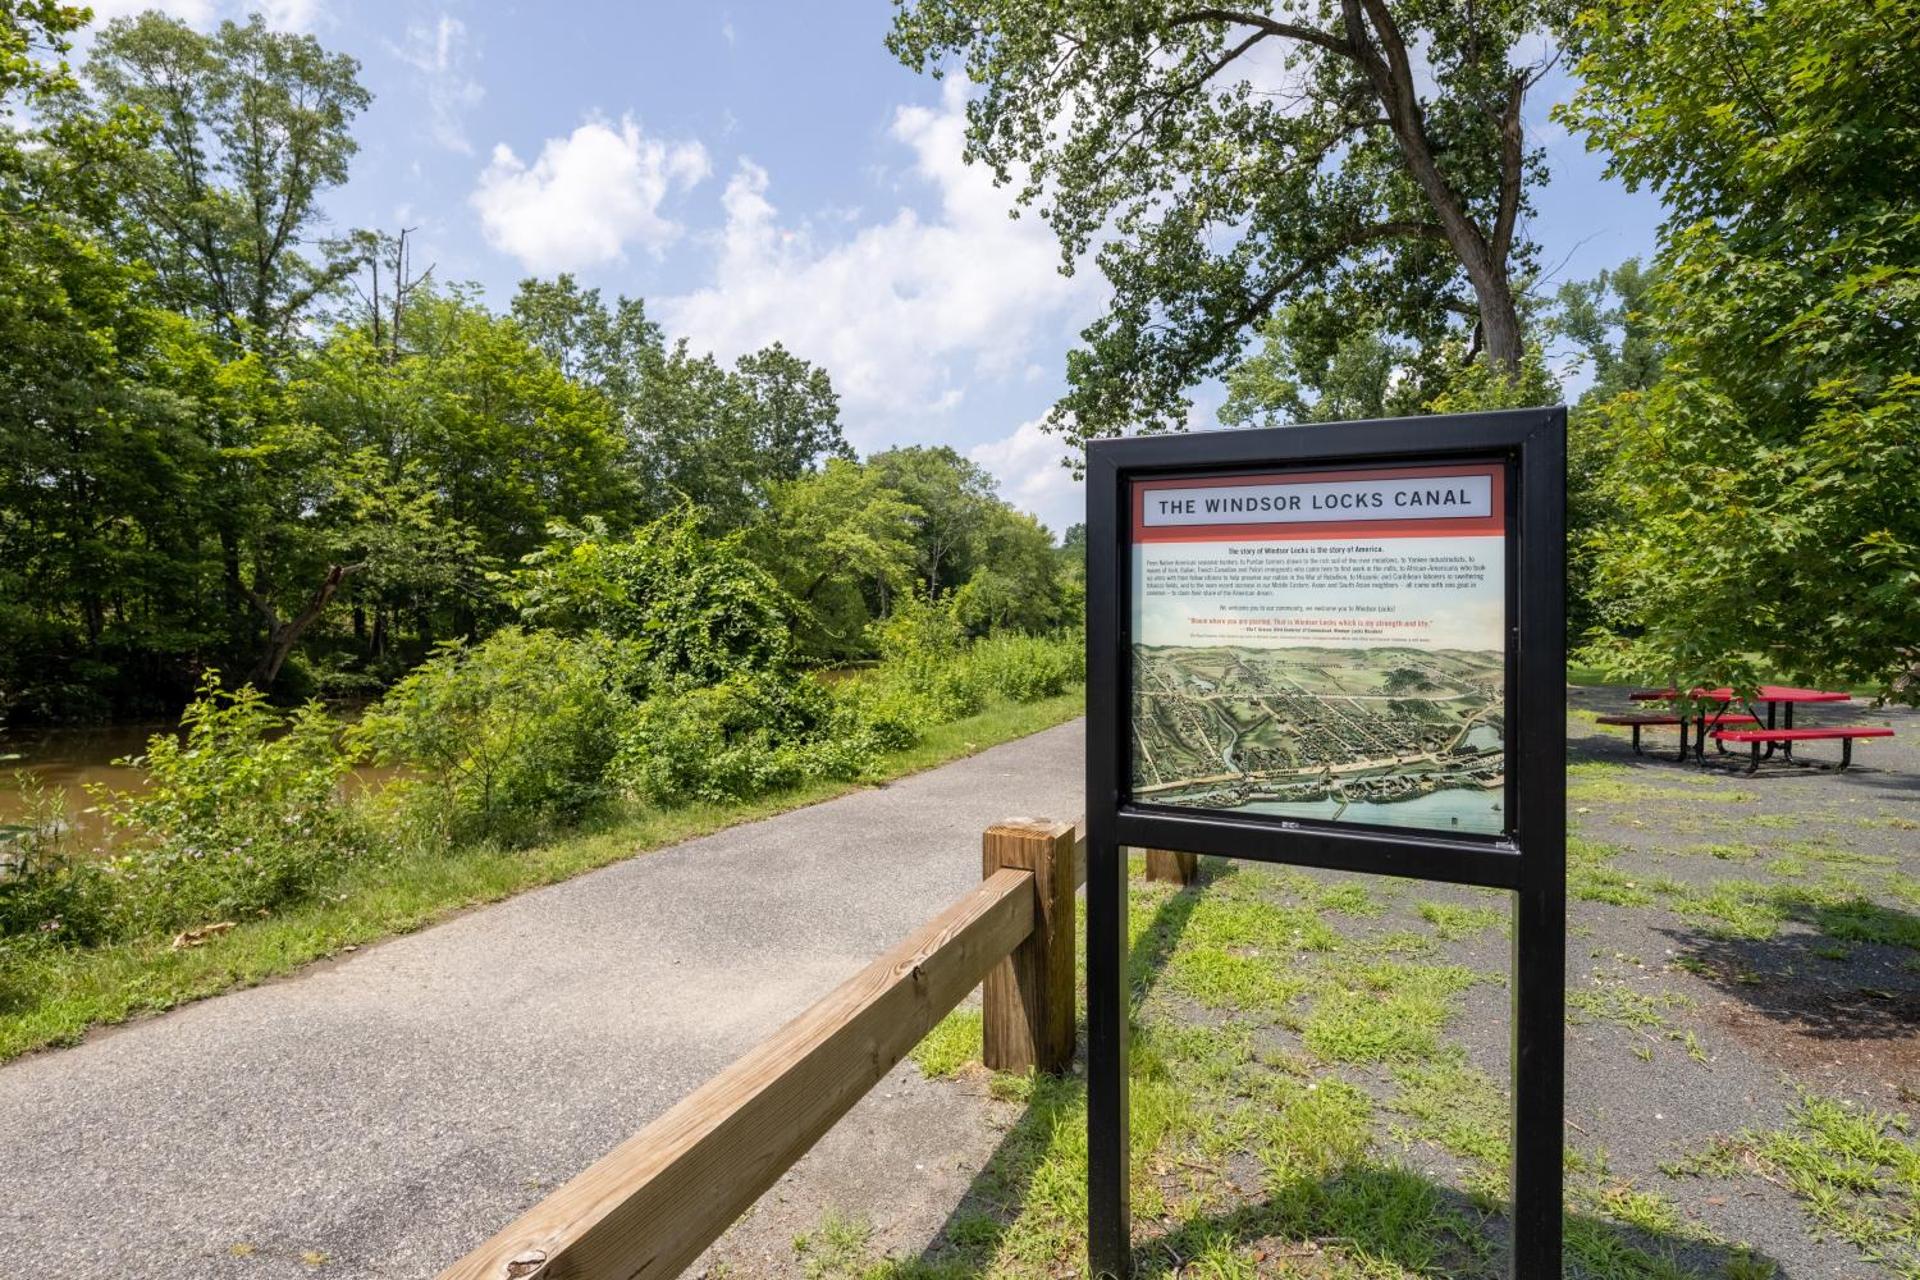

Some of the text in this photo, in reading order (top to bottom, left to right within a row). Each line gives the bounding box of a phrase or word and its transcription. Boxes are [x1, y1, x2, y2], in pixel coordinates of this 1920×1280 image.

[1159, 489, 1472, 515] THE WINDSOR LOCKS CANAL
[1240, 548, 1255, 556] story
[1329, 547, 1345, 555] story
